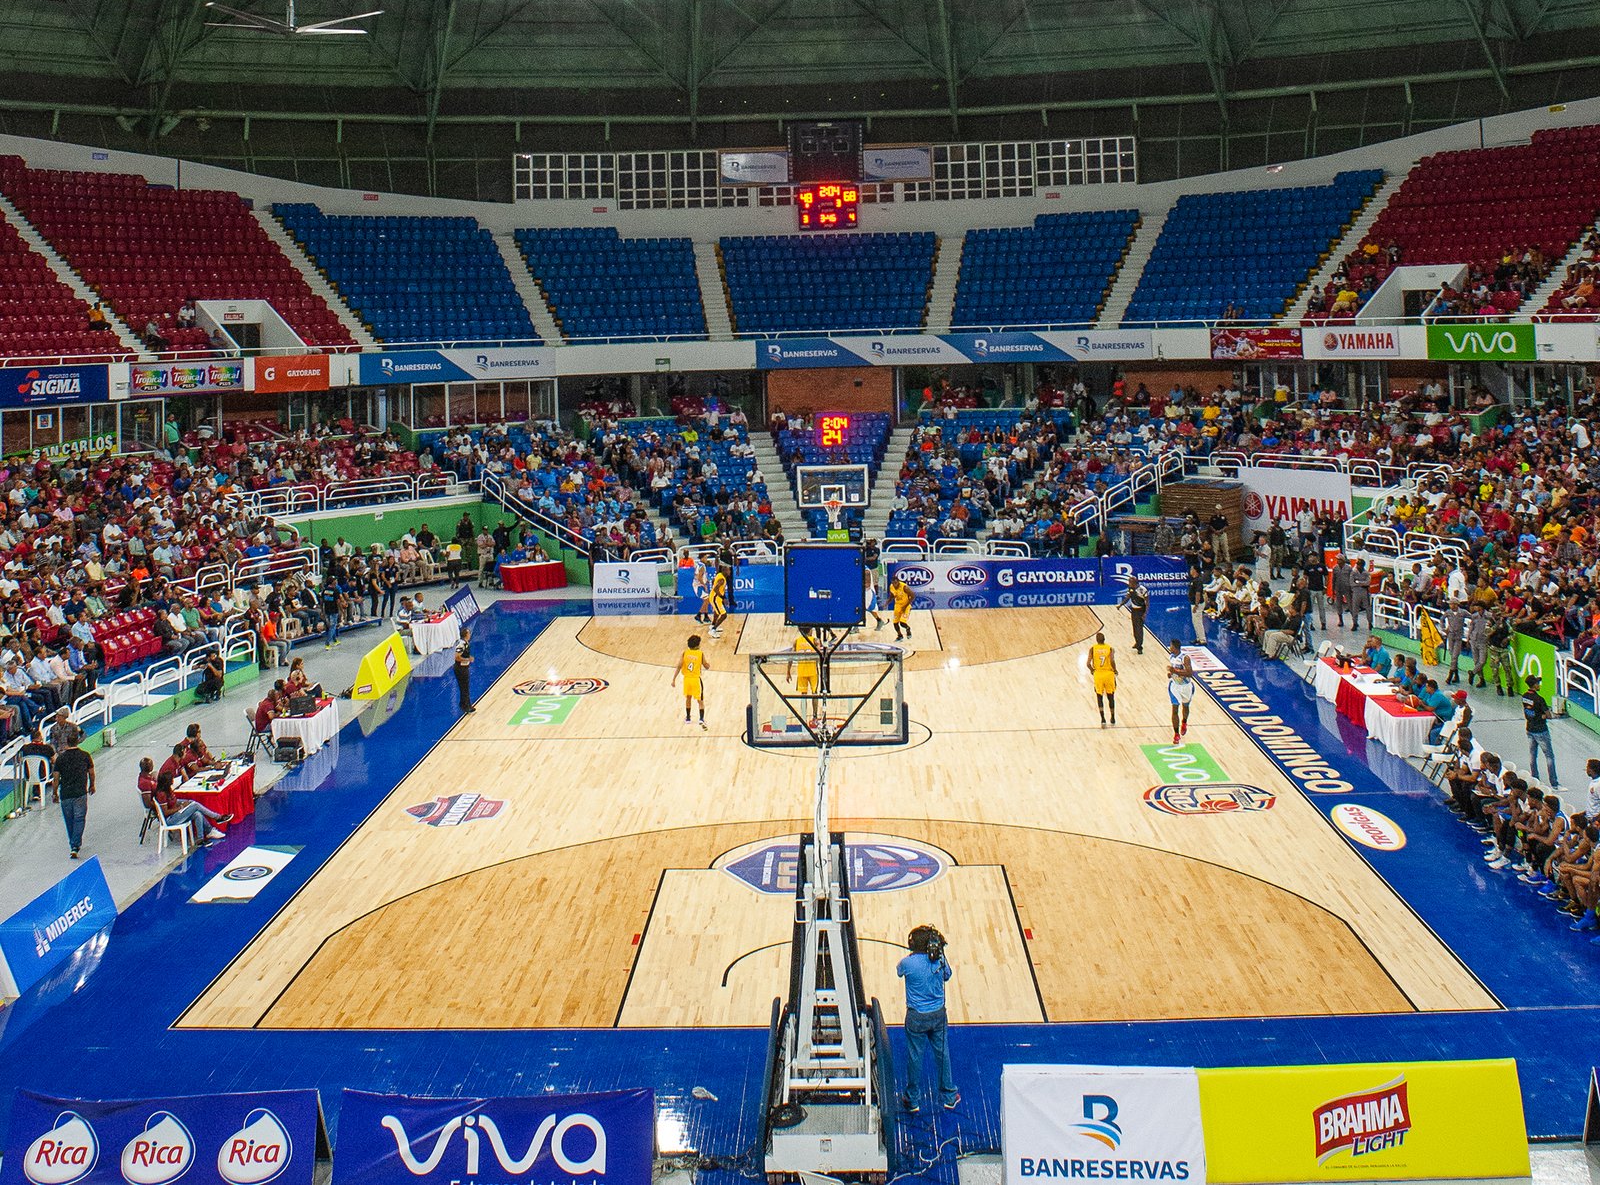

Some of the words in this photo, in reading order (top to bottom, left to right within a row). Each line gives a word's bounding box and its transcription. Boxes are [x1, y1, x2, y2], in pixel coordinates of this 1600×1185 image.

[819, 186, 840, 197] 2:04
[843, 190, 856, 201] 68
[800, 193, 812, 203] 48
[1092, 342, 1145, 350] BANRESERVAS
[1338, 332, 1394, 349] YAMAHA
[783, 349, 837, 358] BANRESERVAS
[886, 347, 940, 355] BANRESERVAS
[989, 344, 1043, 353] BANRESERVAS
[394, 363, 441, 372] BANRESERVAS
[490, 359, 539, 368] BANRESERVAS
[135, 372, 167, 385] Tropical
[172, 370, 204, 383] Tropical
[209, 369, 240, 381] Tropical
[287, 369, 321, 377] GATORADE
[31, 379, 80, 395] SIGMA
[822, 417, 848, 429] 2:04
[822, 430, 841, 445] 24
[32, 445, 59, 458] SAN
[62, 435, 113, 453] CARLOS
[897, 570, 931, 581] OPAL
[951, 570, 985, 581] OPAL
[1016, 570, 1095, 583] GATORADE
[1137, 572, 1189, 581] BANRESER
[687, 662, 694, 672] 4
[1197, 671, 1270, 713] SANTO
[1239, 715, 1355, 794] DOMINGO
[45, 895, 94, 943] MIDEREC
[1319, 1093, 1405, 1145] BRAHMA
[1352, 1128, 1408, 1156] LIGHT
[35, 1140, 88, 1167] Rica
[131, 1140, 184, 1167] Rica
[228, 1139, 281, 1166] Rica
[1020, 1157, 1189, 1180] BANRESERVAS
